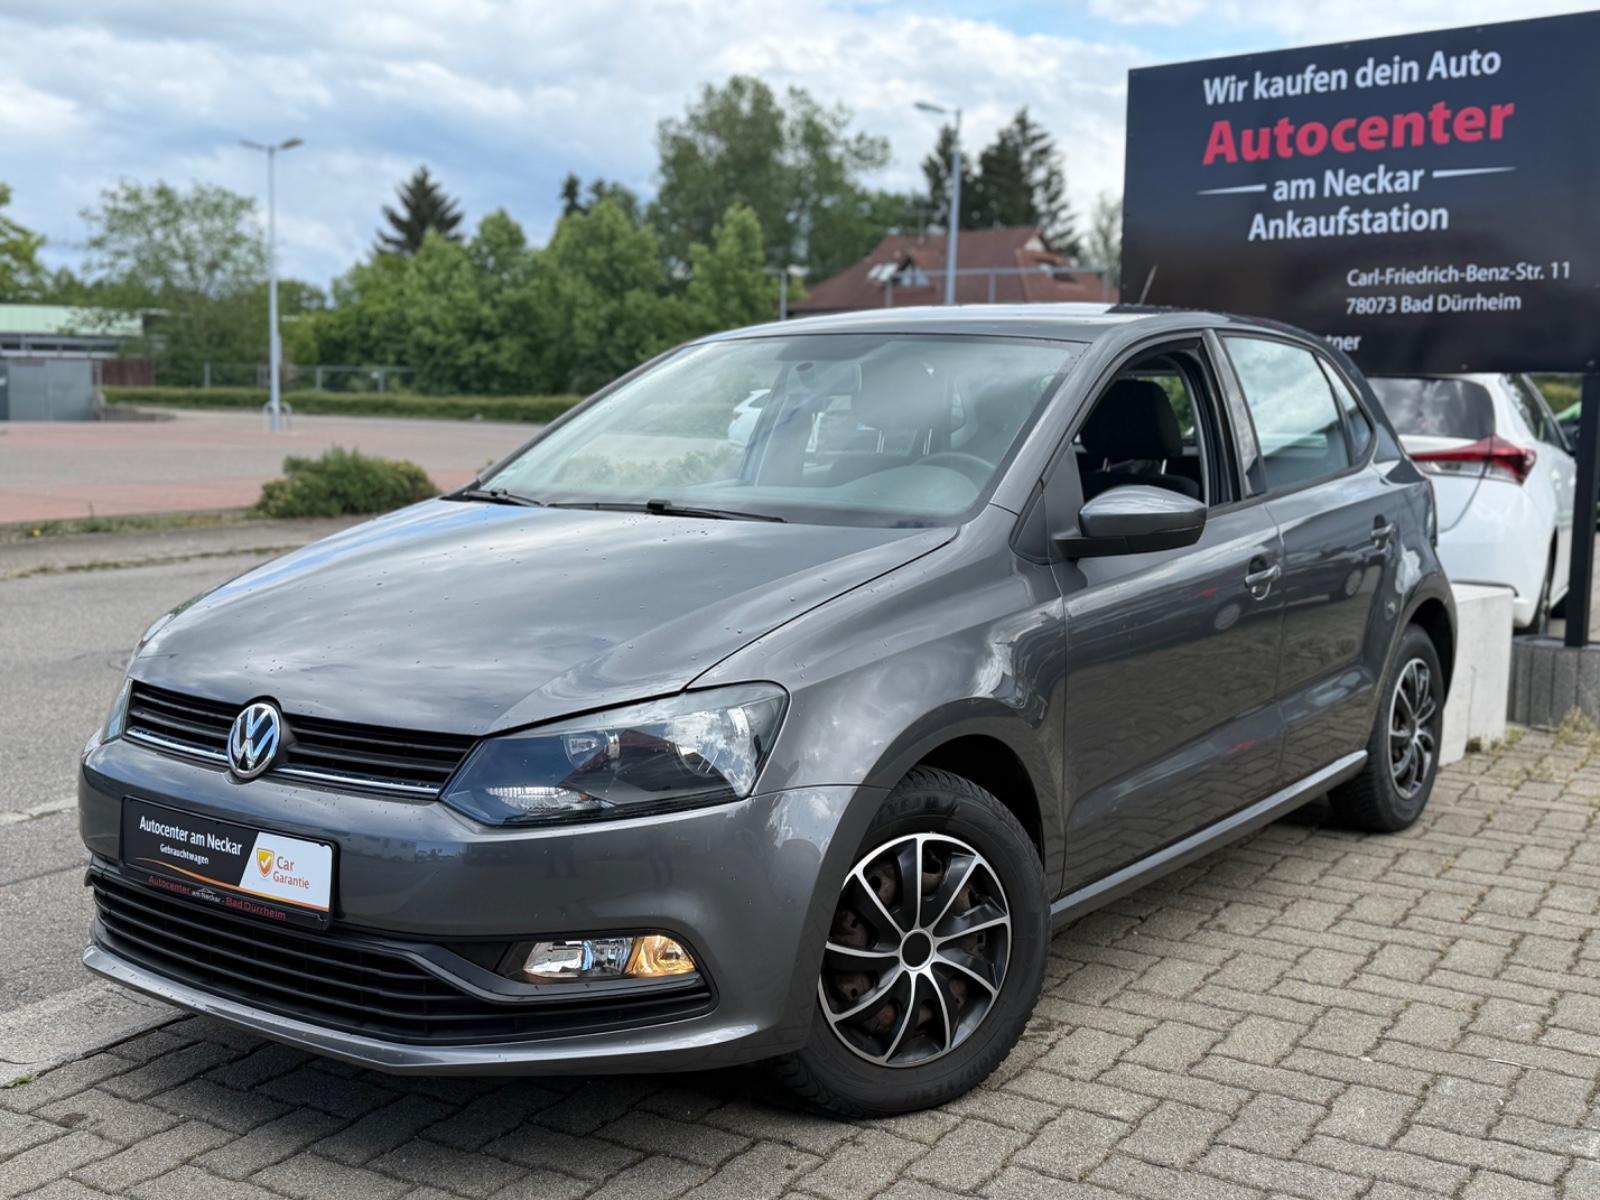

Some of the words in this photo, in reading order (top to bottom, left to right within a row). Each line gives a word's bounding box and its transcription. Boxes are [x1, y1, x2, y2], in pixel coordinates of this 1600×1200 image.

[1203, 74, 1249, 106] Wir
[1253, 63, 1348, 100] kaufen
[1355, 55, 1420, 88] dein
[1426, 49, 1502, 81] Auto
[1202, 100, 1515, 165] Autocenter
[1272, 177, 1316, 202] am
[1323, 164, 1425, 198] Neckar
[1248, 203, 1449, 242] Ankaufstation
[1346, 262, 1545, 287] Carl-Friedrich-Benz-Str.
[1550, 261, 1571, 279] 11
[1346, 296, 1397, 315] 78073
[1401, 295, 1433, 314] Bad
[1437, 292, 1522, 313] Dürrheim
[139, 816, 189, 842] Autocenter
[190, 831, 205, 847] am
[207, 832, 243, 856] Neckar
[159, 843, 209, 865] Gebrauchtwagen
[276, 855, 295, 872] Car
[148, 874, 192, 895] Autocenter
[272, 871, 310, 889] Garantie
